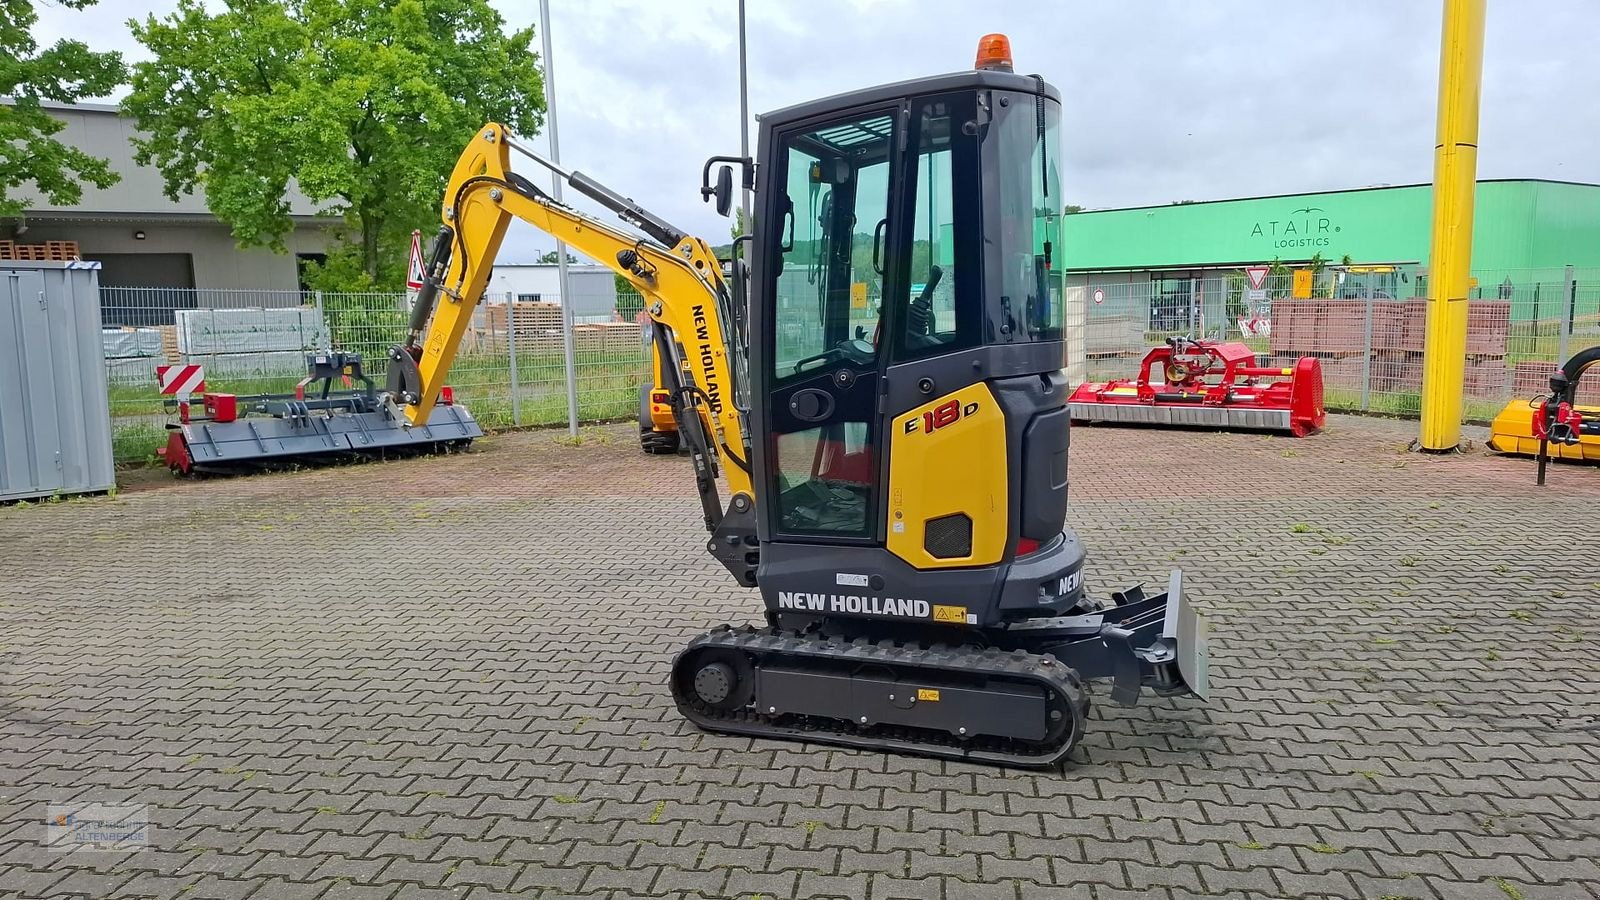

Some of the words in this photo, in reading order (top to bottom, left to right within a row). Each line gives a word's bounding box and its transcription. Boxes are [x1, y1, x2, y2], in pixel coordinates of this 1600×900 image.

[1274, 238, 1329, 248] LOGISTICS
[692, 305, 708, 340] NEW
[700, 343, 722, 414] HOLLAND
[1058, 569, 1080, 596] NEW
[778, 591, 826, 611] NEW
[830, 594, 930, 618] HOLLAND
